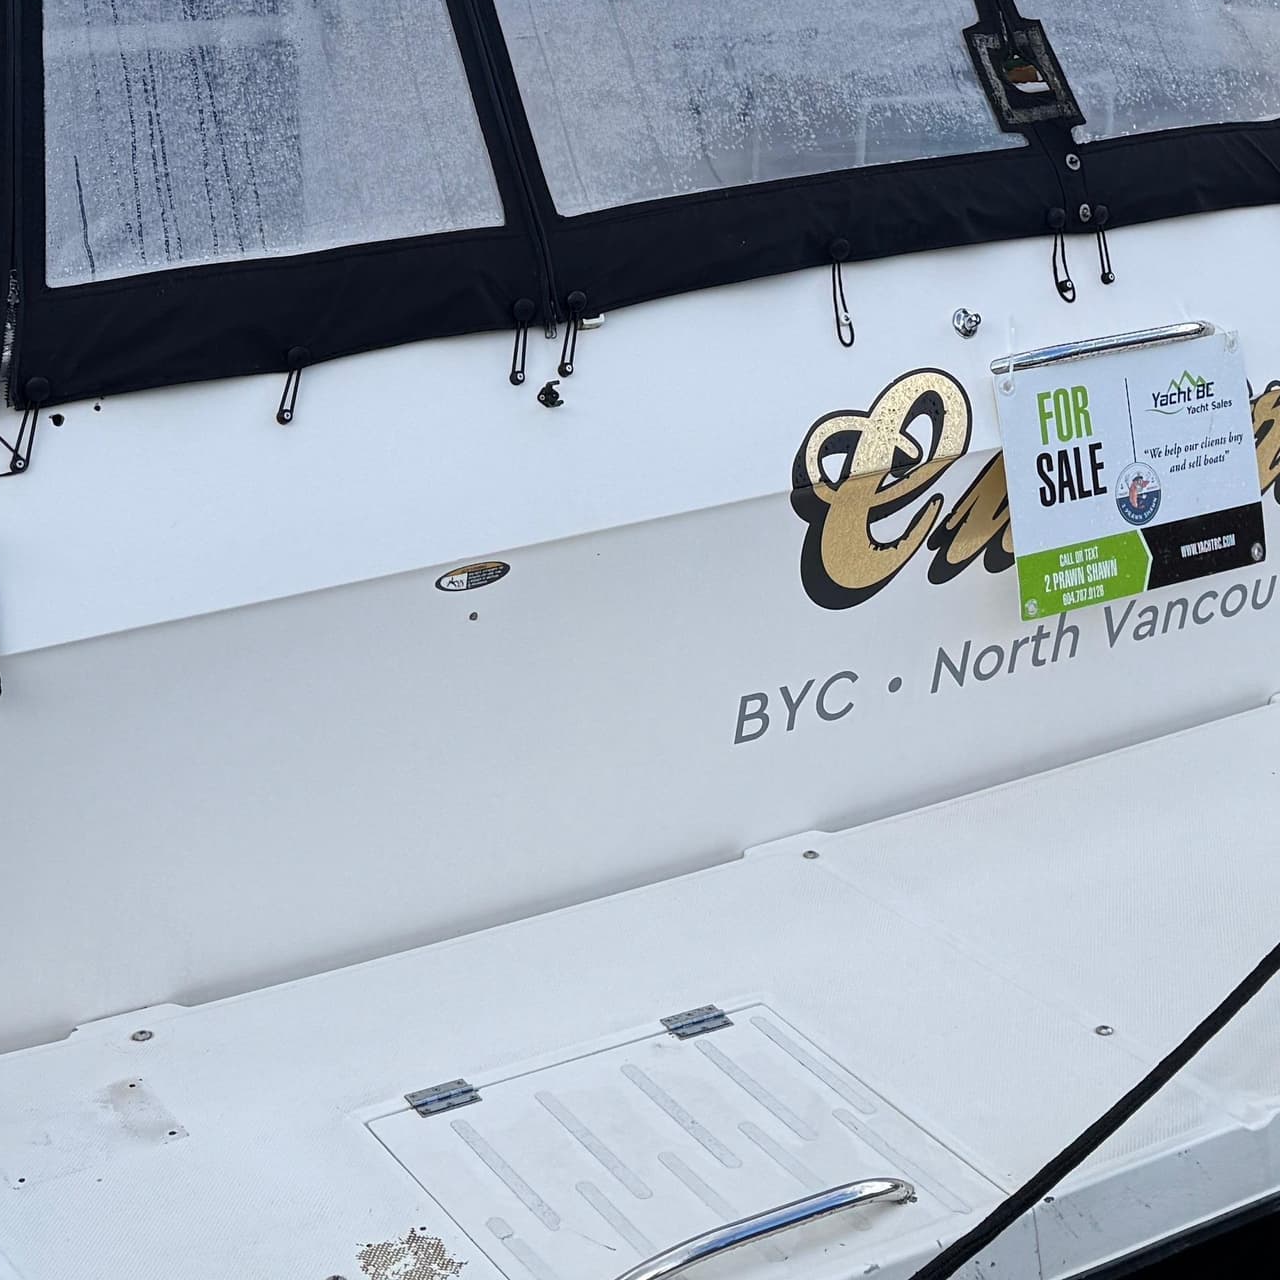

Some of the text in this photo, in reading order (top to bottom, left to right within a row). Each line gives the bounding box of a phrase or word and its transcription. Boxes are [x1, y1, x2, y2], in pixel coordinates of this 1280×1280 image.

[1152, 387, 1192, 408] Yacht
[1186, 399, 1233, 415] Yacht Sales
[1036, 385, 1093, 446] FOR
[1164, 443, 1182, 458] help
[1184, 443, 1199, 452] our
[1200, 436, 1226, 449] clients
[1228, 431, 1243, 445] buy
[1036, 442, 1108, 507] SALE
[1169, 459, 1186, 473] and
[1188, 456, 1201, 469] sell
[1060, 546, 1099, 567] CALL OR TEXT
[1044, 558, 1118, 593] 2 PRAWN SHAWN
[734, 670, 859, 744] BYC
[930, 608, 1080, 694] North
